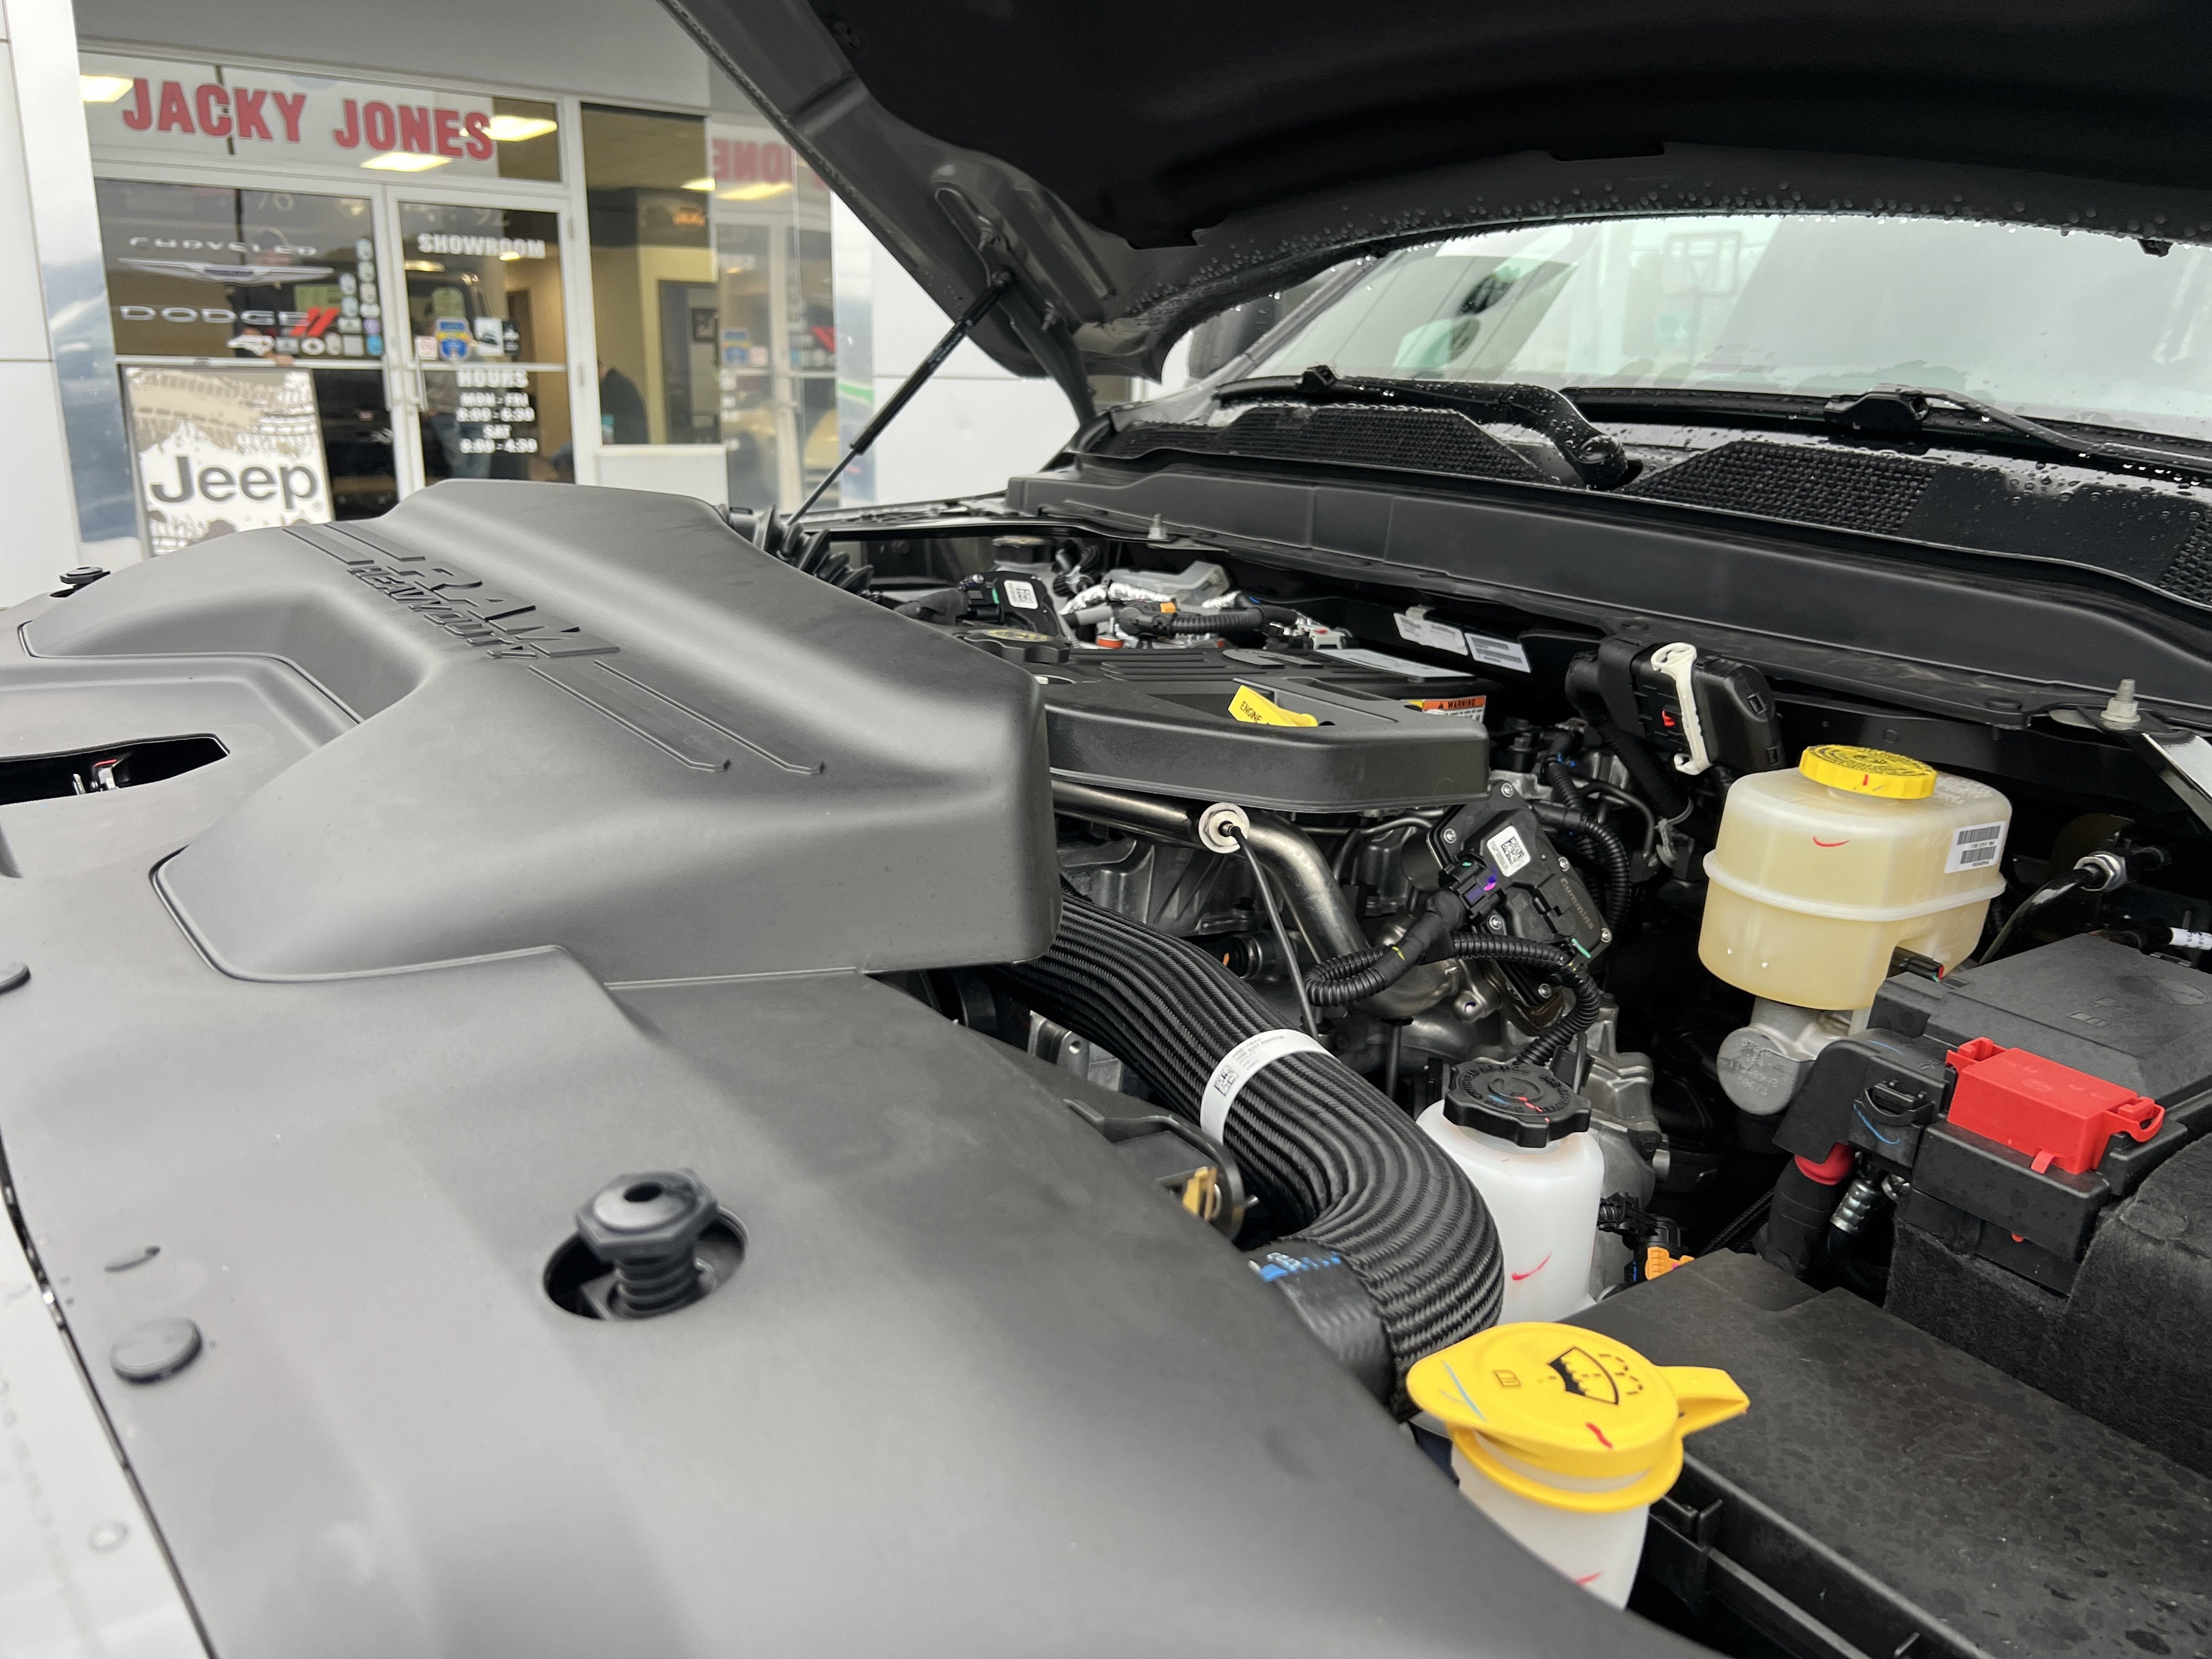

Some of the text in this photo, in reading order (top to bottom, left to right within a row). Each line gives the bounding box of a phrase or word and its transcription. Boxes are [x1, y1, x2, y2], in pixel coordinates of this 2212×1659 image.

[122, 78, 493, 160] JACKY JONES
[417, 233, 546, 259] SHOWROOM
[120, 306, 311, 326] DODGE
[456, 368, 529, 388] HOURS
[483, 424, 512, 439] SAT
[150, 456, 318, 510] Jeep
[347, 565, 537, 659] HEAVY DUTY
[1239, 701, 1262, 723] ENGINE
[1448, 698, 1475, 709] WARNING
